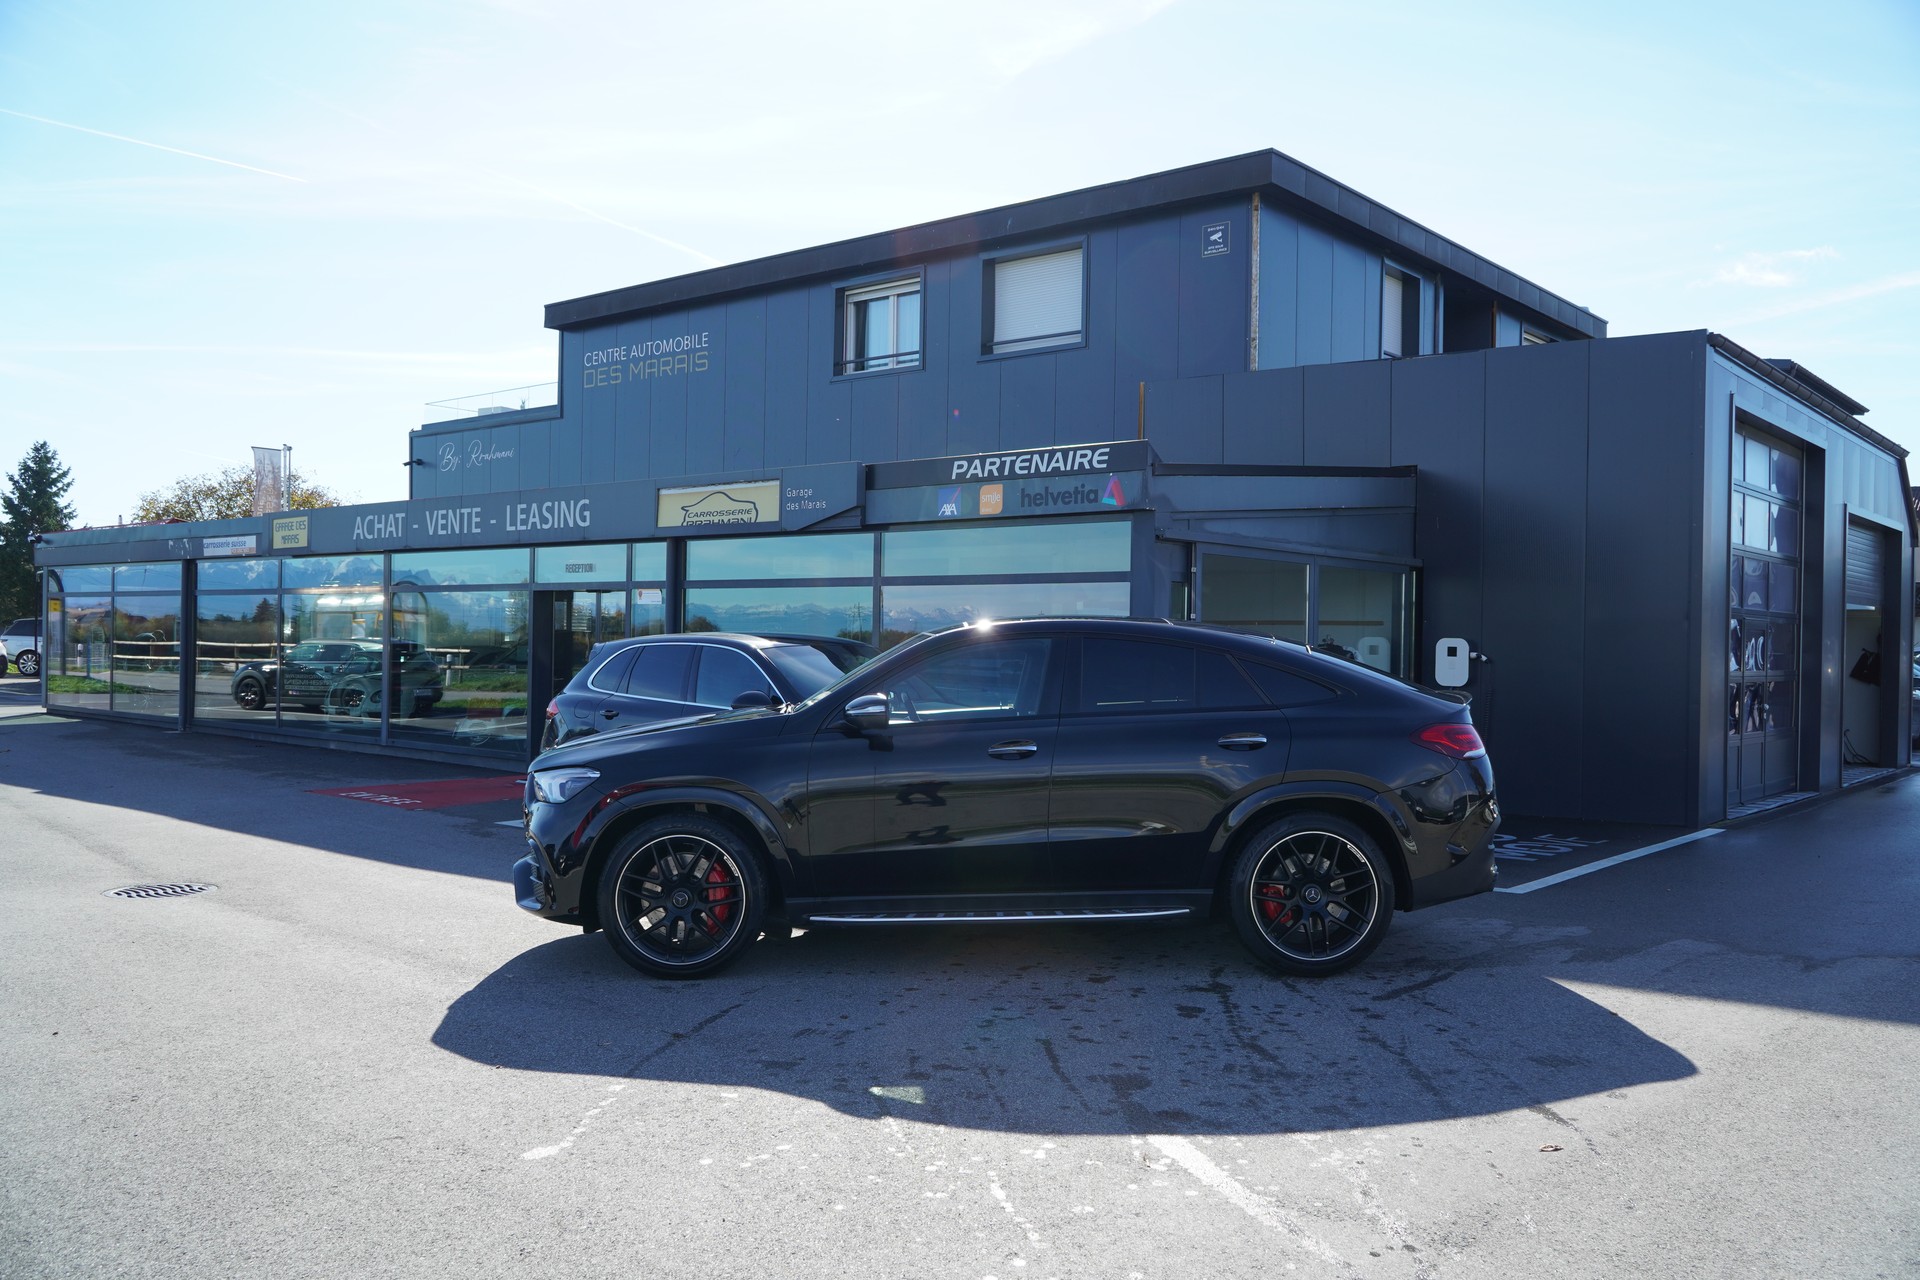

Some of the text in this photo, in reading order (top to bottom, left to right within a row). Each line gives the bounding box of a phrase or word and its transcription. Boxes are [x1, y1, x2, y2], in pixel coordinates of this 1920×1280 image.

[584, 332, 709, 367] CENTRE AUTOMOBILE
[583, 351, 709, 388] DES MARAIS
[466, 439, 515, 468] Rrahmani
[951, 448, 1110, 480] PARTENAIRE
[786, 487, 813, 499] Garage
[786, 499, 827, 511] des Marais
[981, 491, 1001, 504] smile
[1020, 484, 1099, 508] helvetia
[353, 513, 406, 540] ACHAT
[425, 507, 482, 535] VENTE
[506, 499, 591, 532] LEASING
[687, 508, 753, 519] CARROSSERIE
[938, 503, 958, 516] AXA
